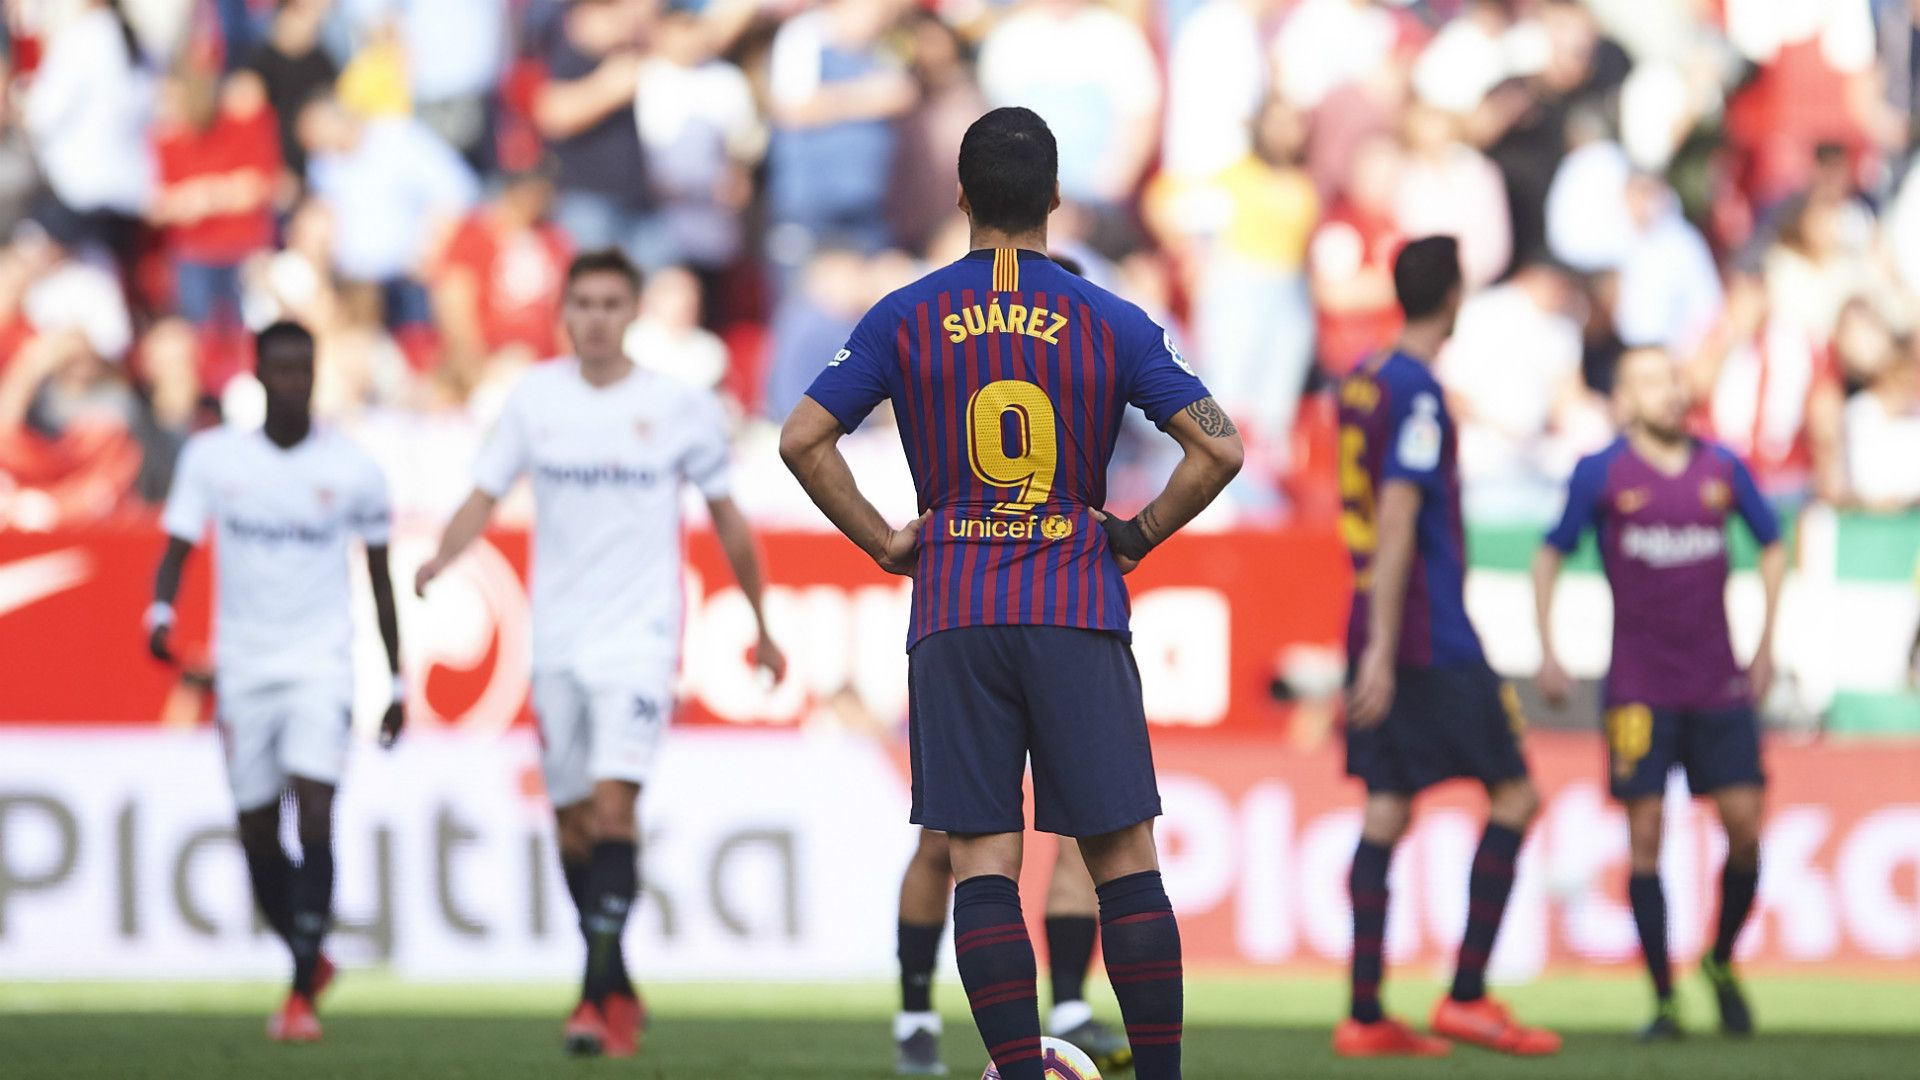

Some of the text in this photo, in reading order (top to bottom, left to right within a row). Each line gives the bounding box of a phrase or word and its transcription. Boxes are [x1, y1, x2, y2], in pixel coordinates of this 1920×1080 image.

[943, 297, 1068, 345] SUÁREZ
[966, 379, 1057, 515] 9
[949, 515, 1038, 539] unicef
